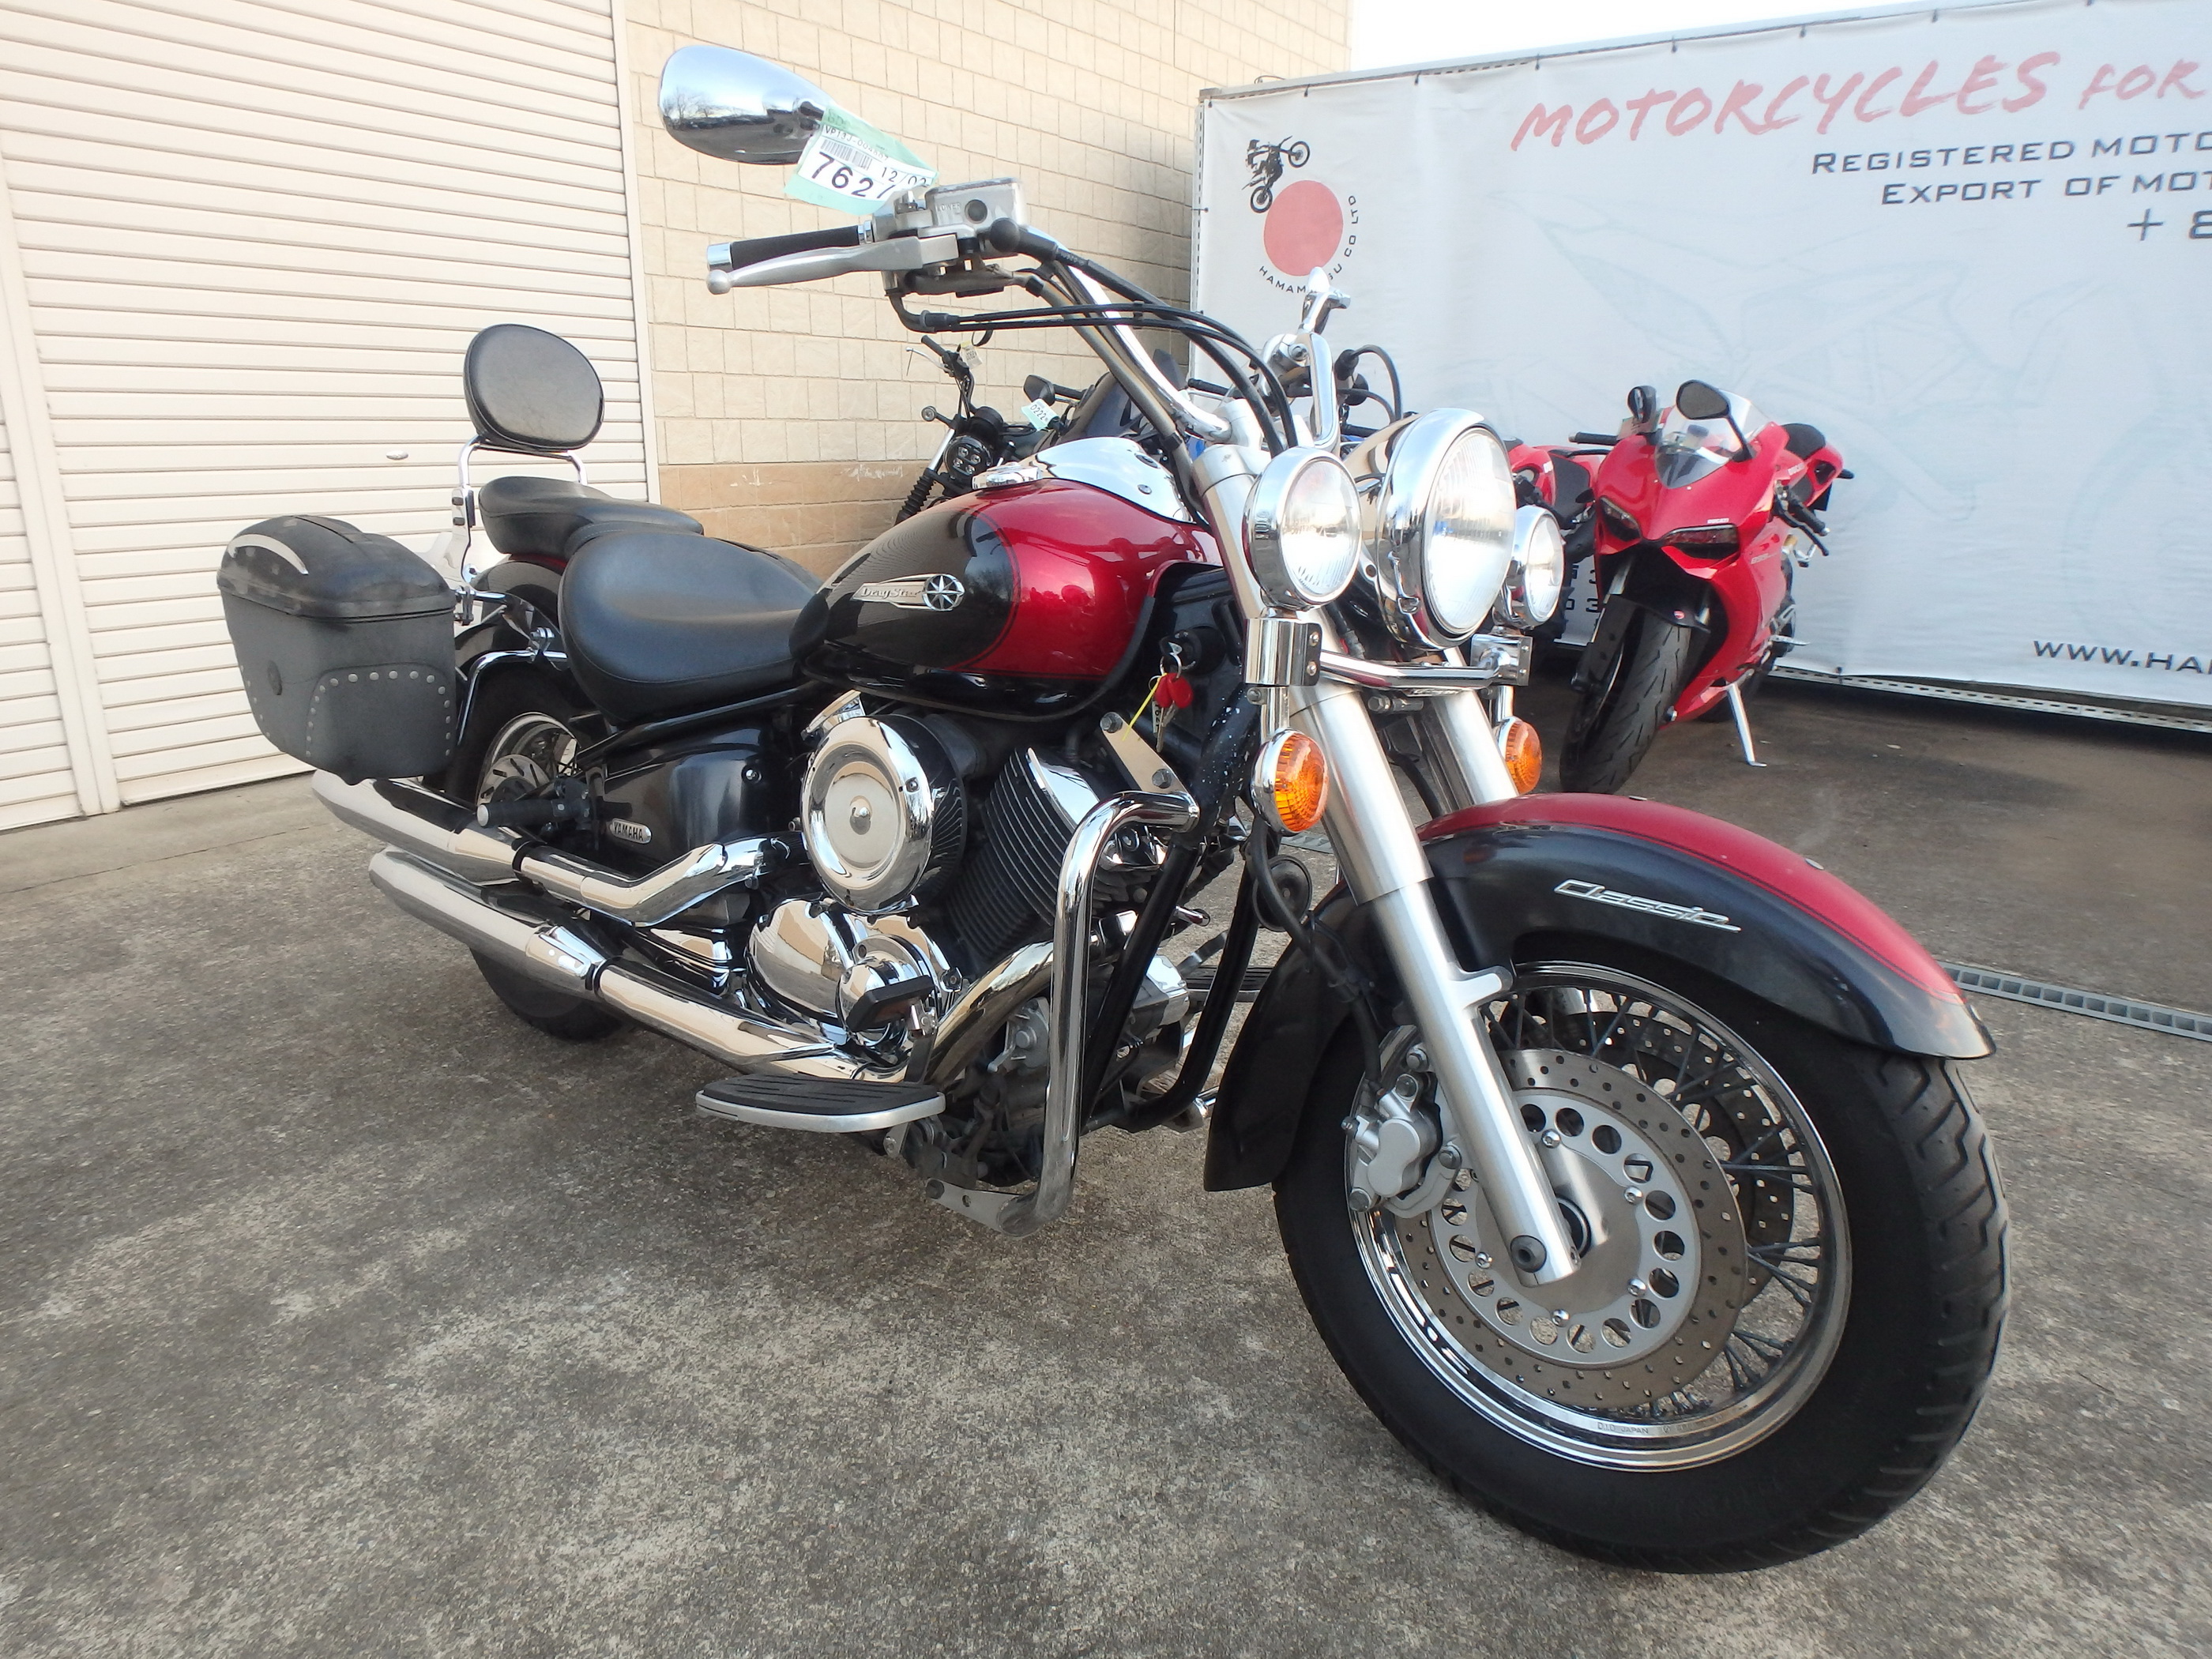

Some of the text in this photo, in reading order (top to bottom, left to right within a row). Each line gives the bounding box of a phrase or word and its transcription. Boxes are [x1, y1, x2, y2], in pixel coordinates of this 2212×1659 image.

[1510, 51, 2206, 152] MOTORCYCLES FOR
[1811, 140, 2075, 175] REGISTERED
[1881, 179, 2042, 205] EXPORT
[2064, 175, 2121, 197] OF
[1348, 194, 1359, 225] LTD
[2033, 640, 2212, 675] WWW.HA
[613, 822, 645, 842] YAMAHA
